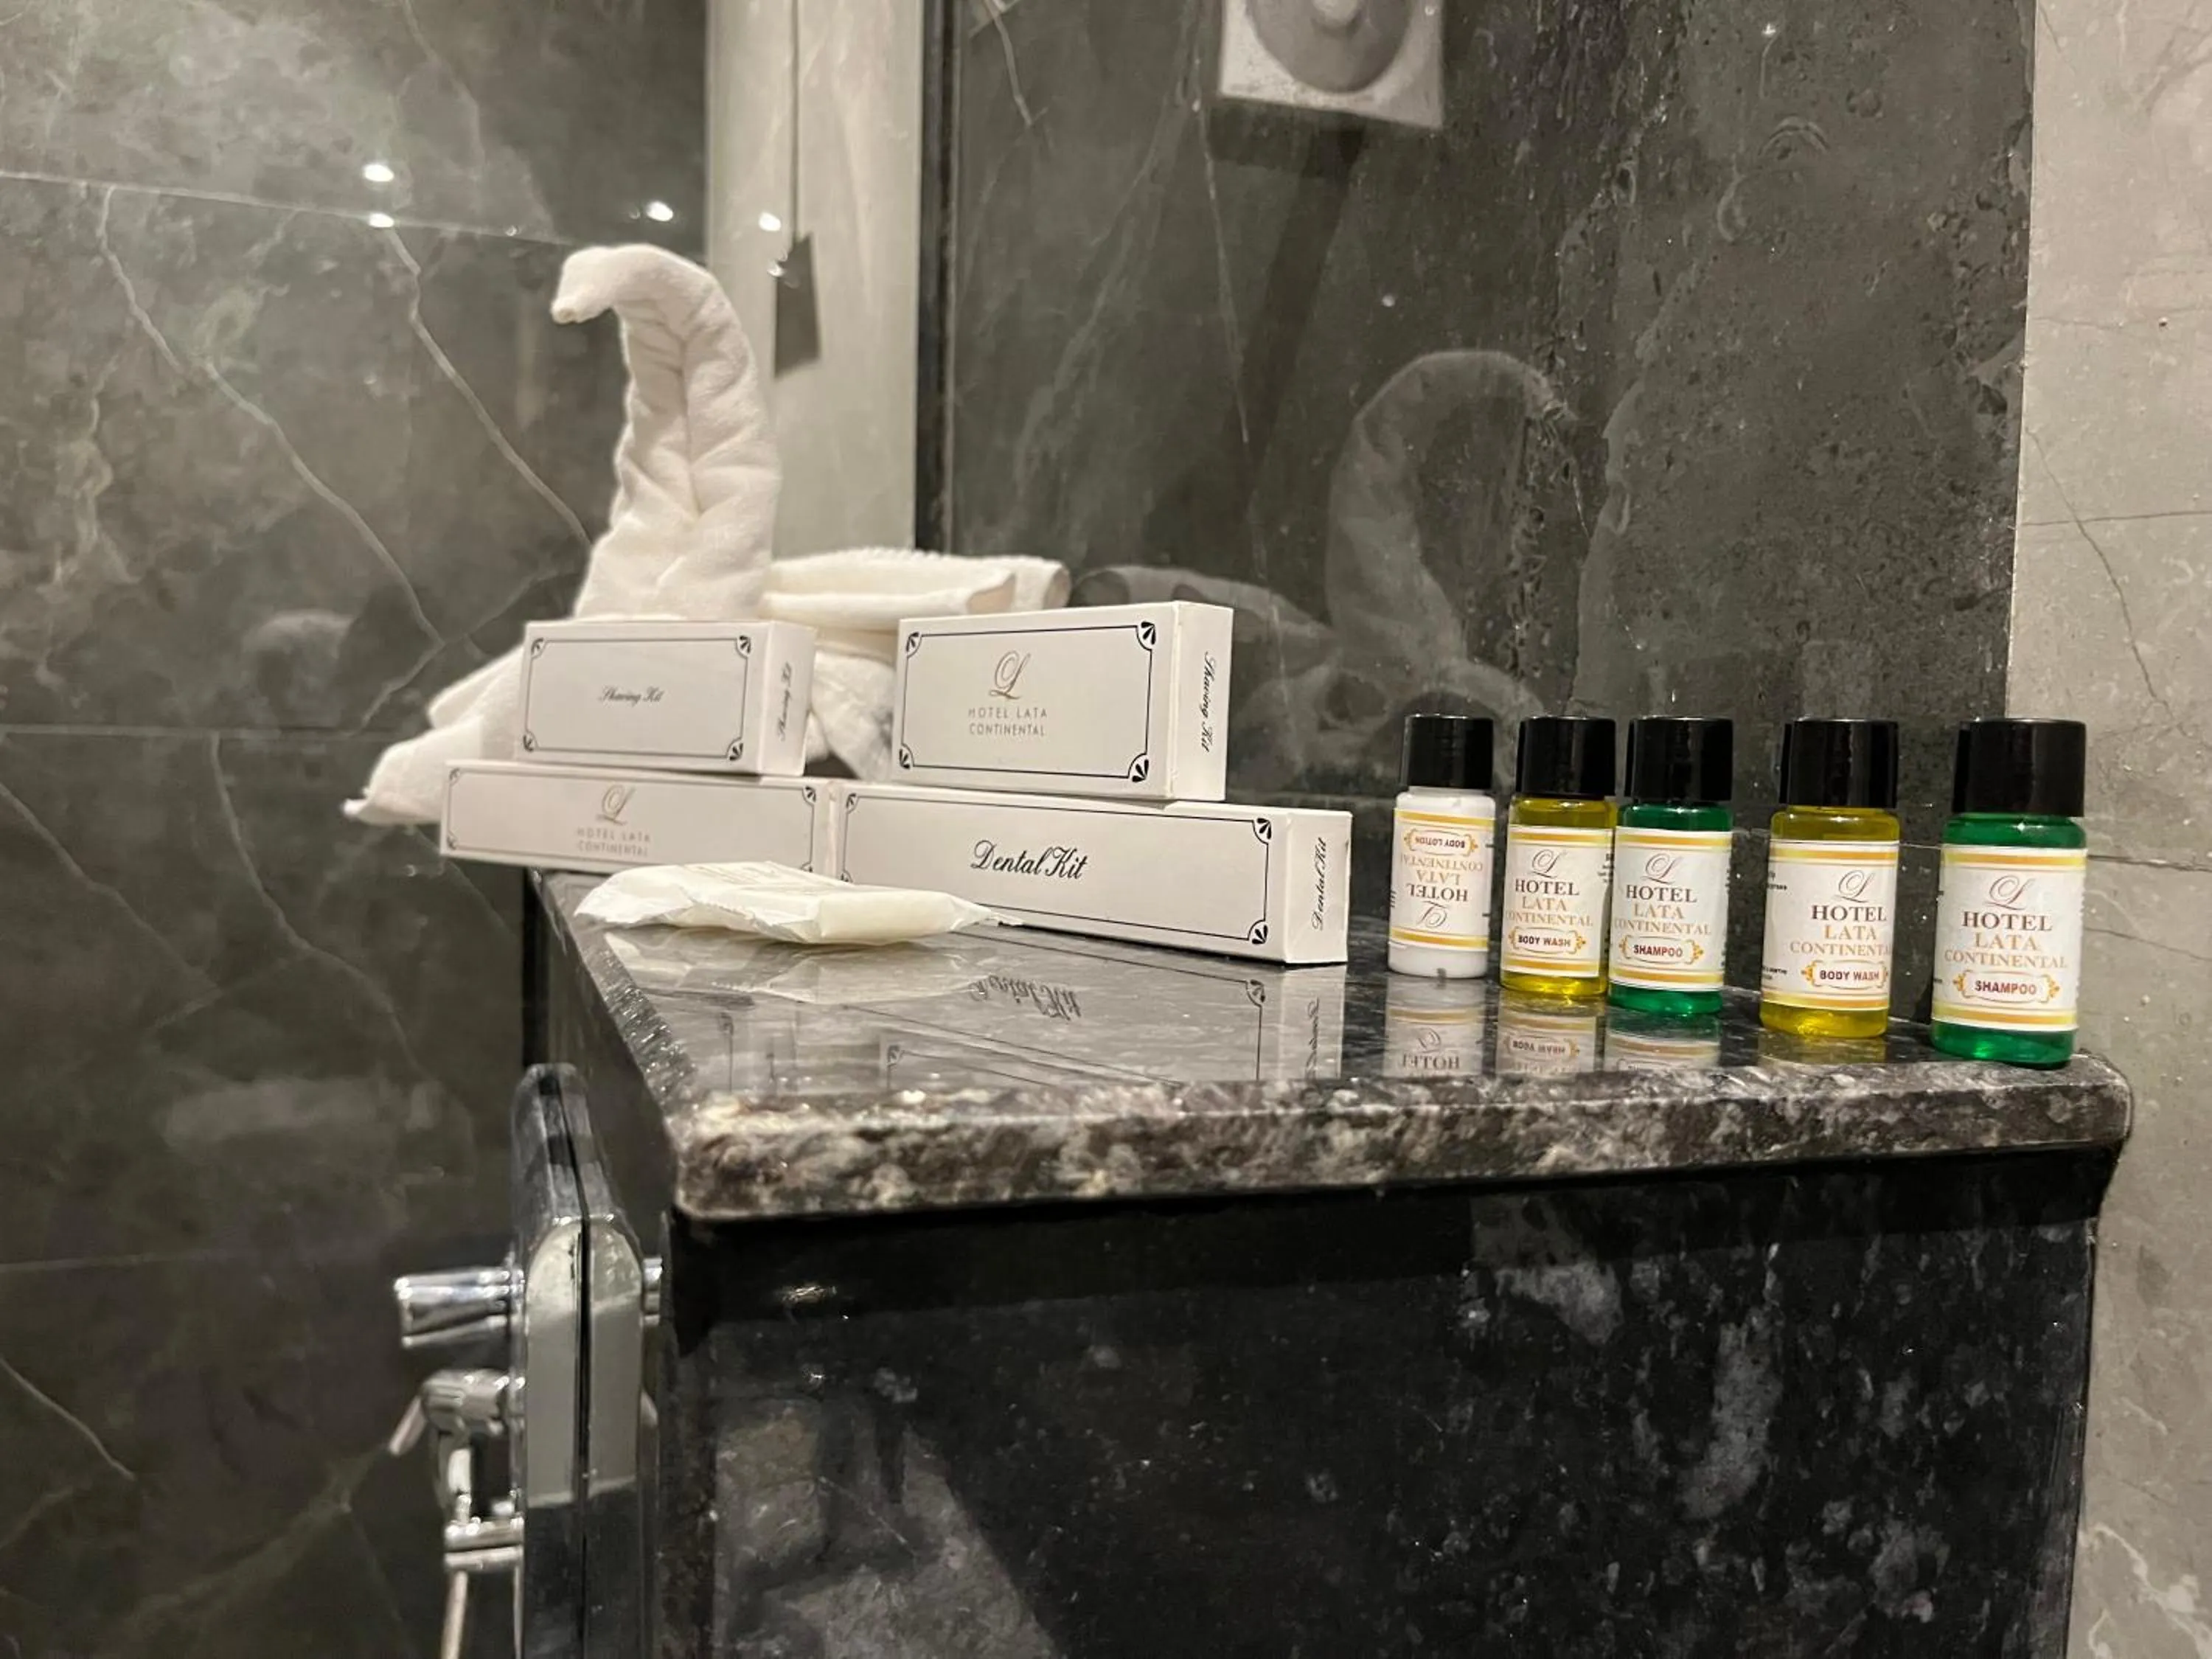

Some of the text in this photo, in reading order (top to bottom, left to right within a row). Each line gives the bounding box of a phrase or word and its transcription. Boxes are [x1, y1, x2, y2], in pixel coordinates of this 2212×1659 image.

[1199, 651, 1217, 753] Shaving Kit
[968, 707, 1048, 719] HOTEL LATA
[969, 723, 1046, 737] CONTINENTAL
[1415, 837, 1466, 849] BODY LOTION
[970, 839, 1088, 880] Dental Kit
[1312, 837, 1326, 931] Dental Kit
[1416, 869, 1461, 885] LATA
[1406, 884, 1469, 902] HOTEL
[1515, 878, 1579, 896] HOTEL
[1626, 885, 1697, 903] HOTEL
[1522, 896, 1567, 911] LATA
[1634, 903, 1685, 919] LATA
[1812, 905, 1887, 922] HOTEL
[1962, 911, 2053, 931] HOTEL
[1518, 935, 1571, 947] BODY WASH
[1825, 925, 1877, 941] LATA
[1975, 932, 2038, 951] LATA
[1633, 945, 1683, 957] SHAMPOO
[1944, 950, 2067, 969] CONTINENTAL
[1820, 970, 1879, 981] BODY WASH
[1975, 981, 2037, 995] SHAMPOO
